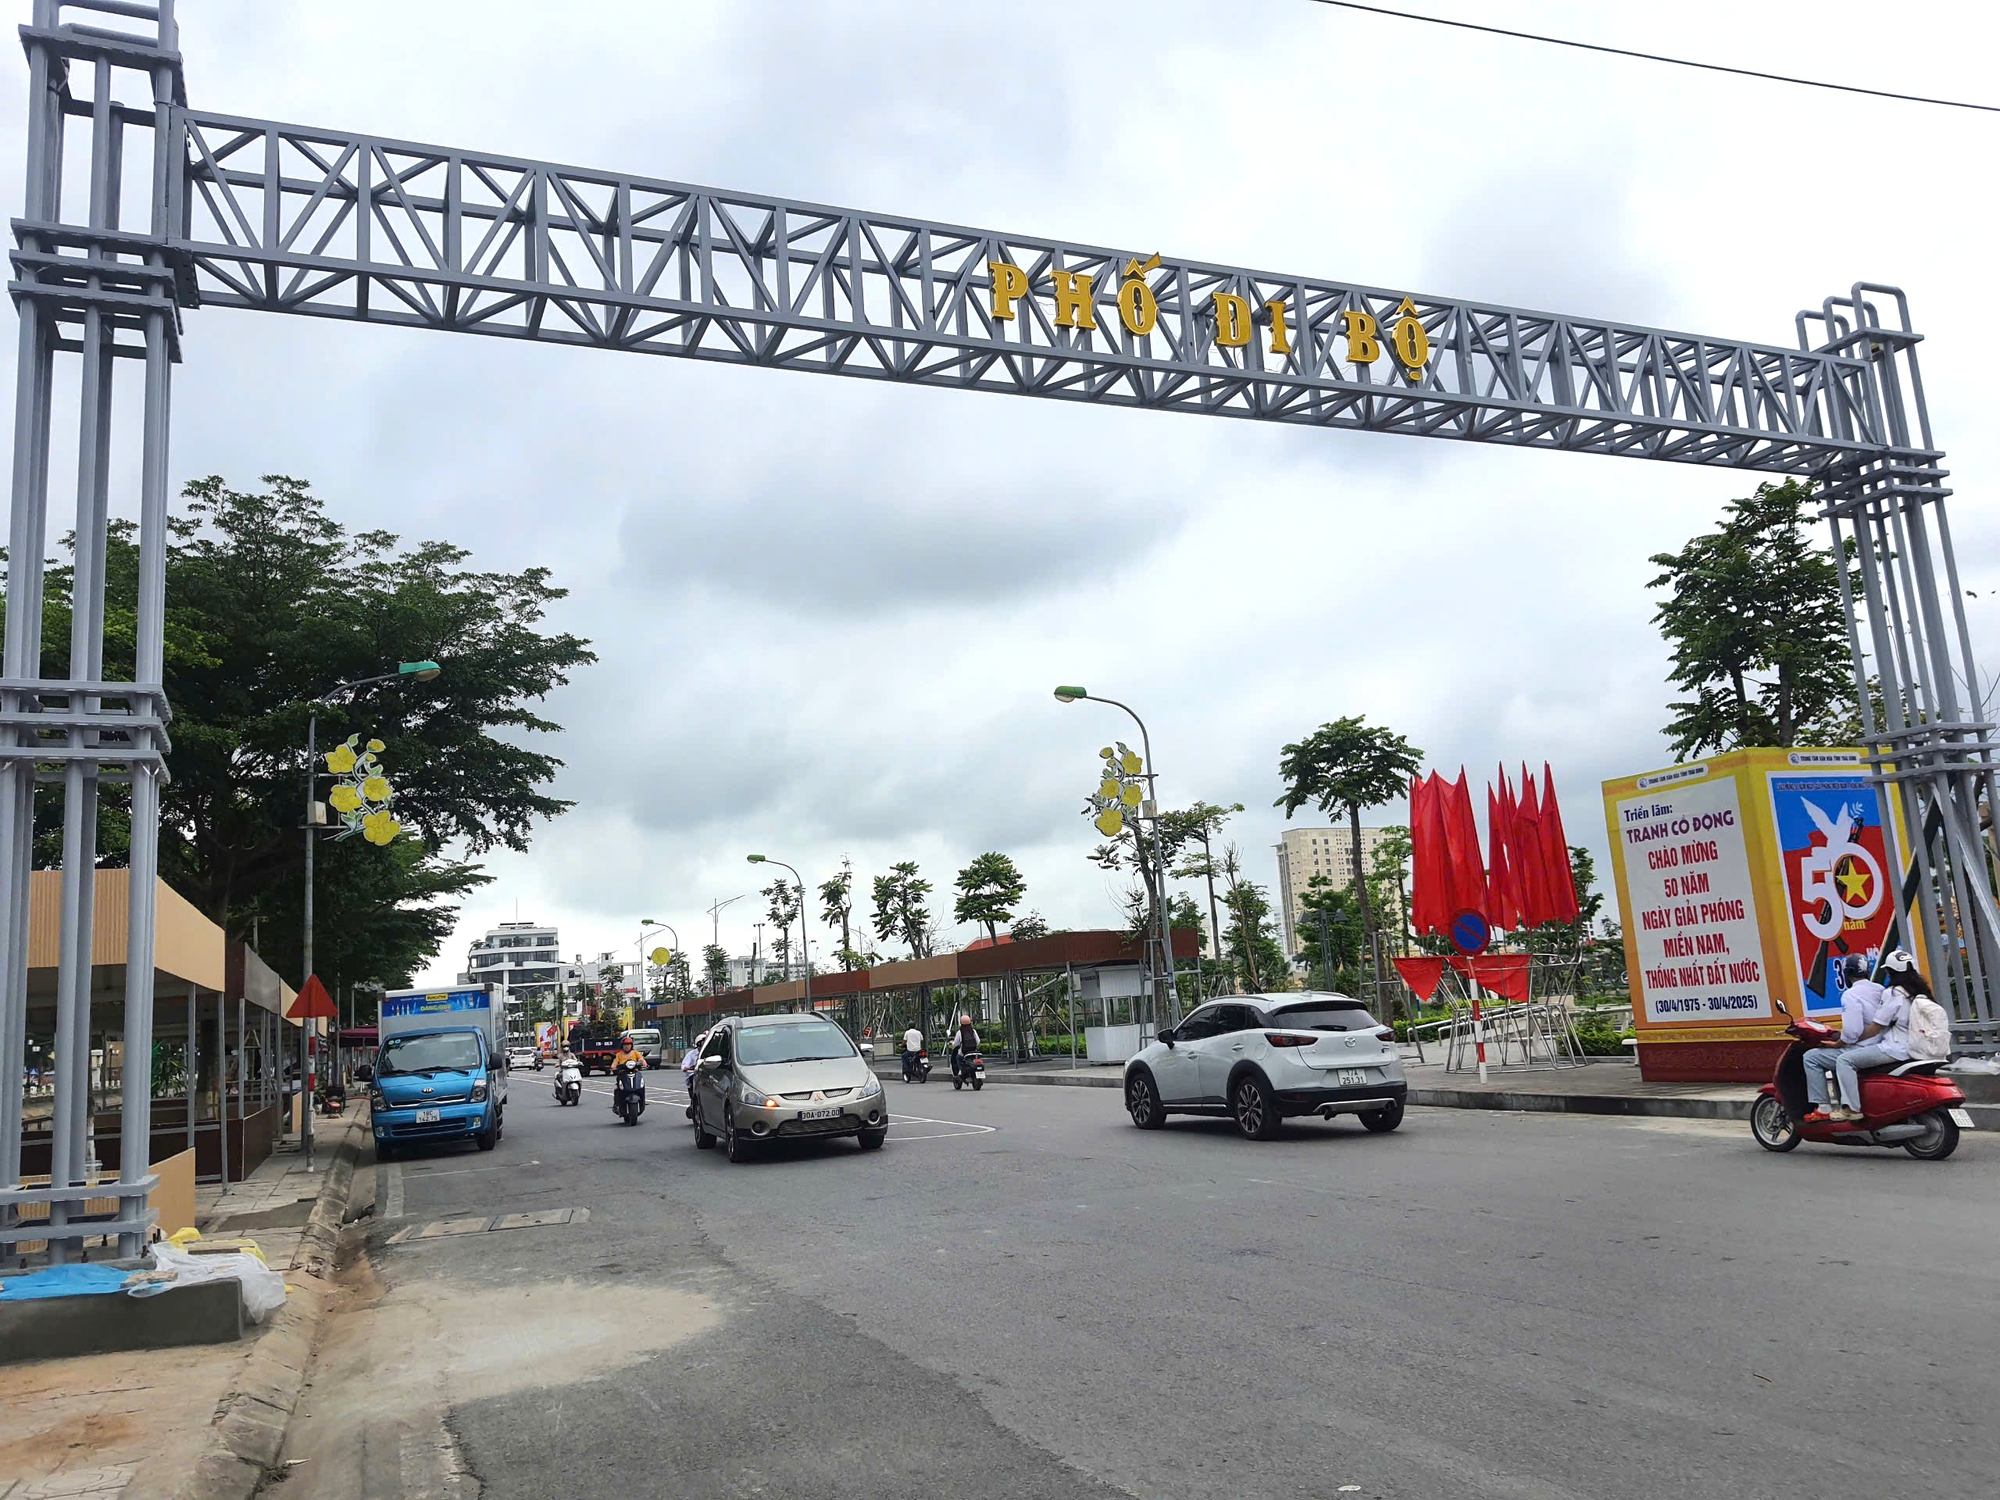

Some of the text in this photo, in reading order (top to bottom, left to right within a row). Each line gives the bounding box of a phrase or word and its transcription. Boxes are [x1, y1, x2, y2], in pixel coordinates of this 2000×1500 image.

[988, 252, 1430, 381] PHỐ DI BỘ
[1624, 804, 1673, 822] Triển lãm:
[1626, 810, 1735, 844] TRANH CỔ ĐỘNG
[1648, 840, 1719, 870] CHÀO MỪNG
[1664, 871, 1710, 898] 50 NĂM
[1801, 842, 1884, 941] 50
[1642, 897, 1745, 930] NGÀY GIẢI PHÓNG
[1663, 931, 1730, 958] MIỀN NAM,
[1645, 957, 1760, 989] THỐNG NHẤT ĐẤT NƯỚC
[1655, 998, 1700, 1014] (30/4/1975
[1709, 995, 1758, 1011] 30/4/2025)
